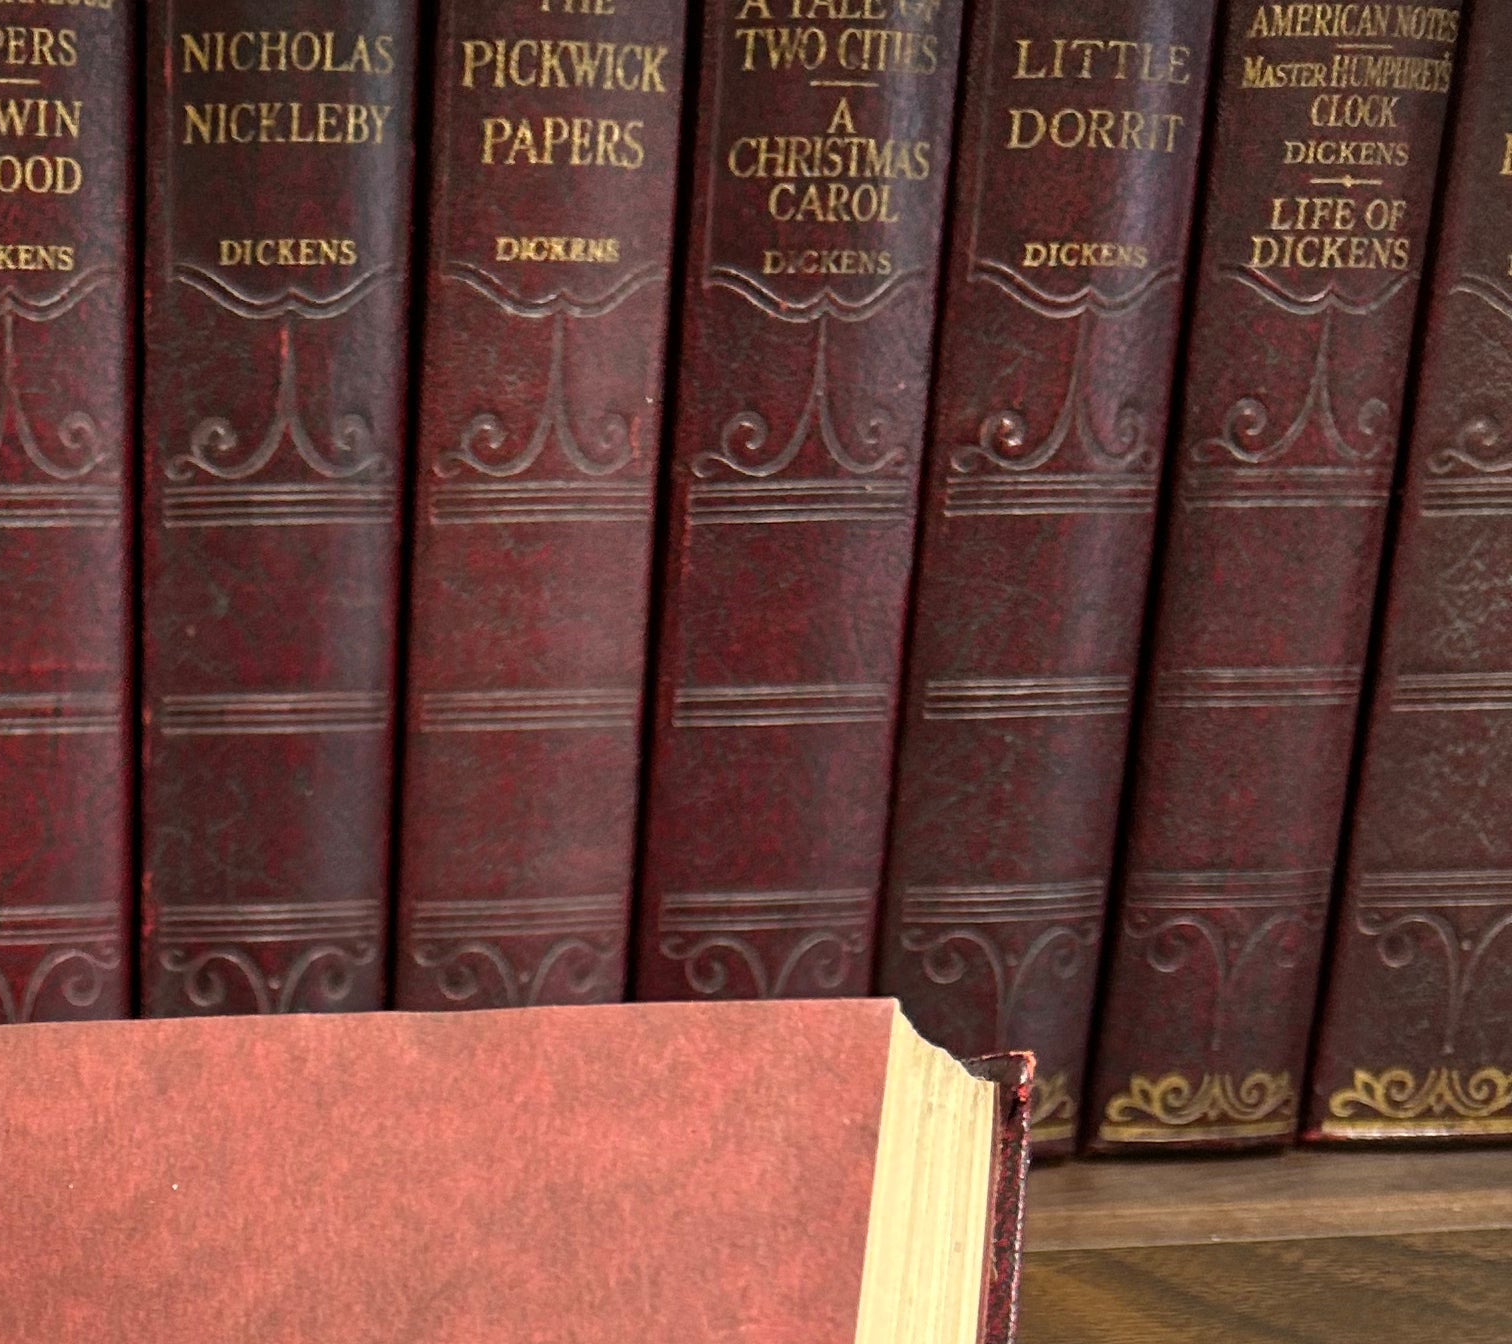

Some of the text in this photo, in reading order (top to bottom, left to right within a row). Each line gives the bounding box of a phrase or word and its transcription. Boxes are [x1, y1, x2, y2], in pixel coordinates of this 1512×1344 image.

[1246, 4, 1460, 43] AMERICAN NOTES
[181, 31, 396, 75] NICHOLAS
[460, 39, 670, 93] PICKWICK
[735, 27, 938, 75] TWO CITIES
[1013, 40, 1191, 86] LITTLE
[183, 103, 391, 145] NICKLEBY
[827, 97, 856, 133] A
[1310, 94, 1401, 128] CLOCK
[481, 117, 645, 170] PAPERS
[1006, 108, 1186, 154] DORRIT
[728, 136, 930, 180] CHRISTMAS
[1284, 141, 1410, 167] DICKENS
[768, 183, 900, 223] CAROL
[1267, 198, 1407, 232] LIFE OF
[220, 240, 357, 267] DICKENS
[496, 236, 620, 263] DICKENS
[763, 249, 892, 276] DICKENS
[1023, 242, 1148, 270] DICKENS
[1251, 235, 1410, 270] DICKENS
